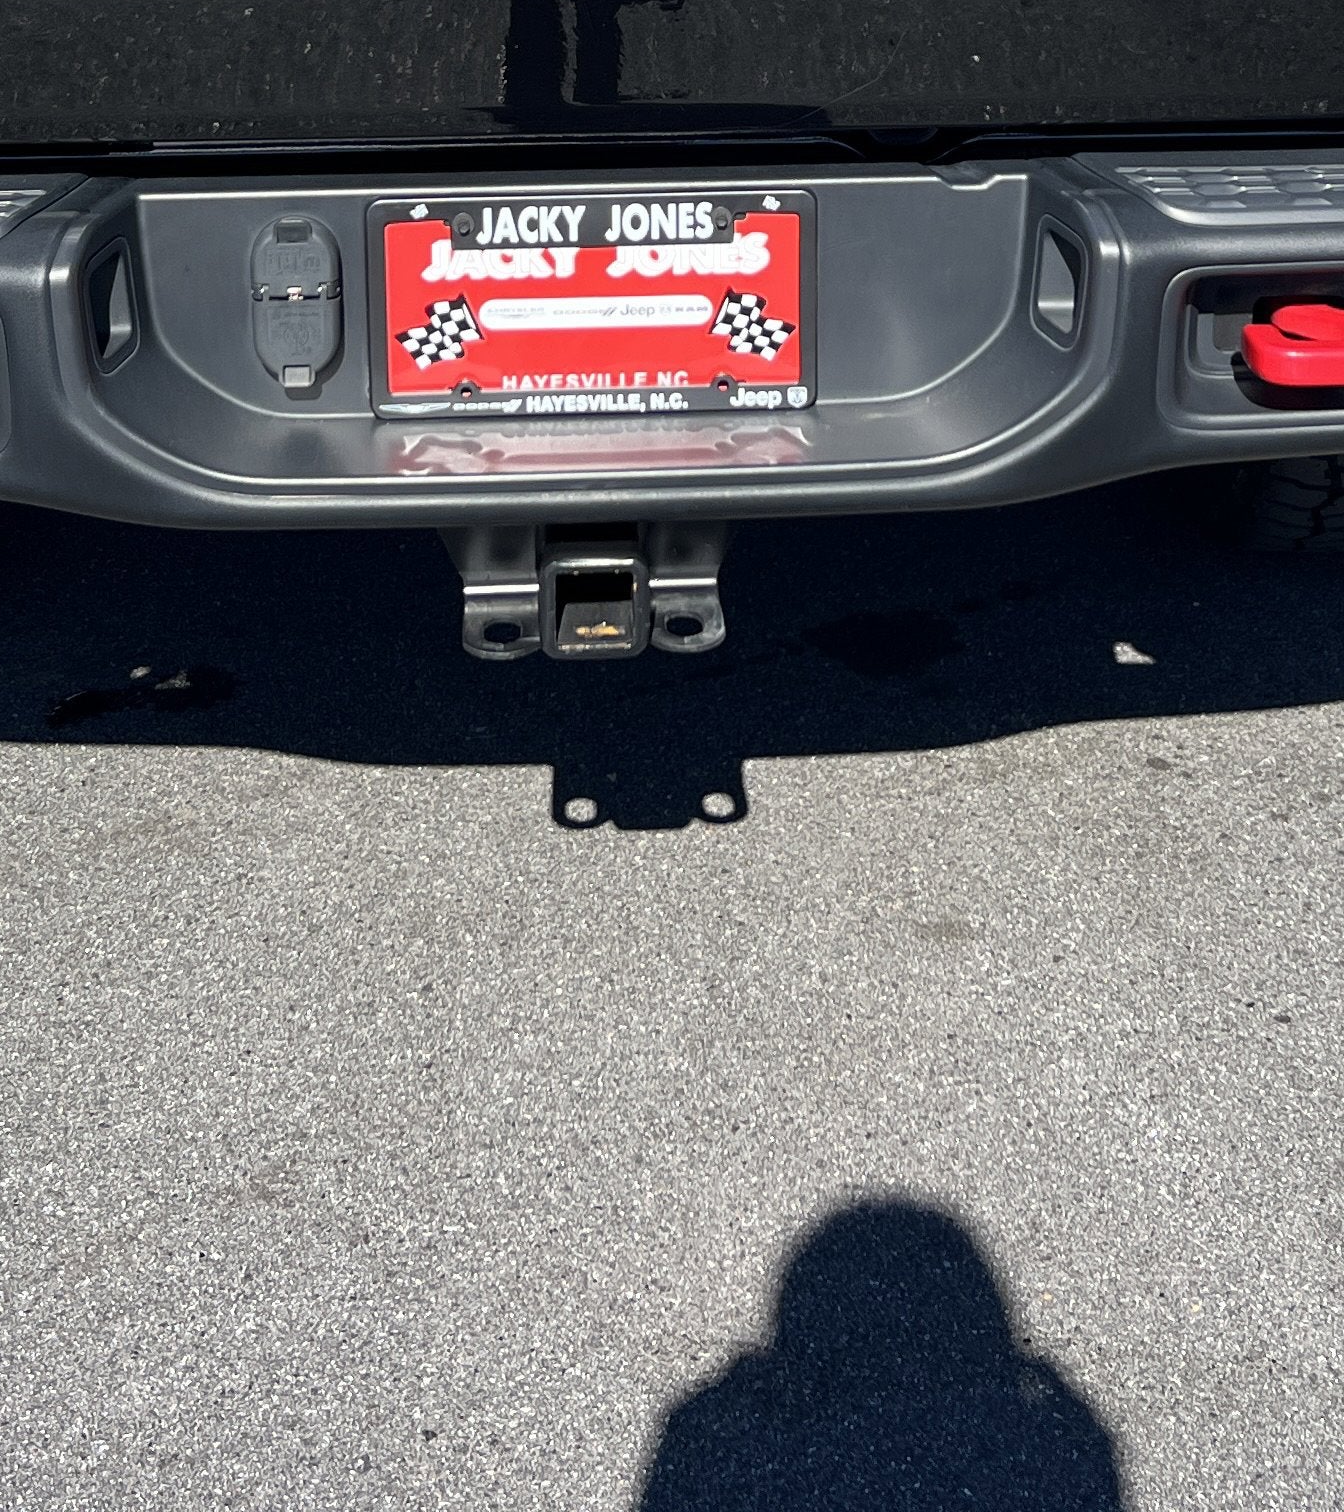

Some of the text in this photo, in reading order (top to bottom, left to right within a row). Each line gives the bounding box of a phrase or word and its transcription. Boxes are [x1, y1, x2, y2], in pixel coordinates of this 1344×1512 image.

[476, 201, 713, 245] JACKY JONES
[620, 303, 655, 317] Jeep
[526, 393, 646, 412] HAYESVILLE,
[649, 392, 689, 410] N.C.
[730, 388, 782, 409] Jeep
